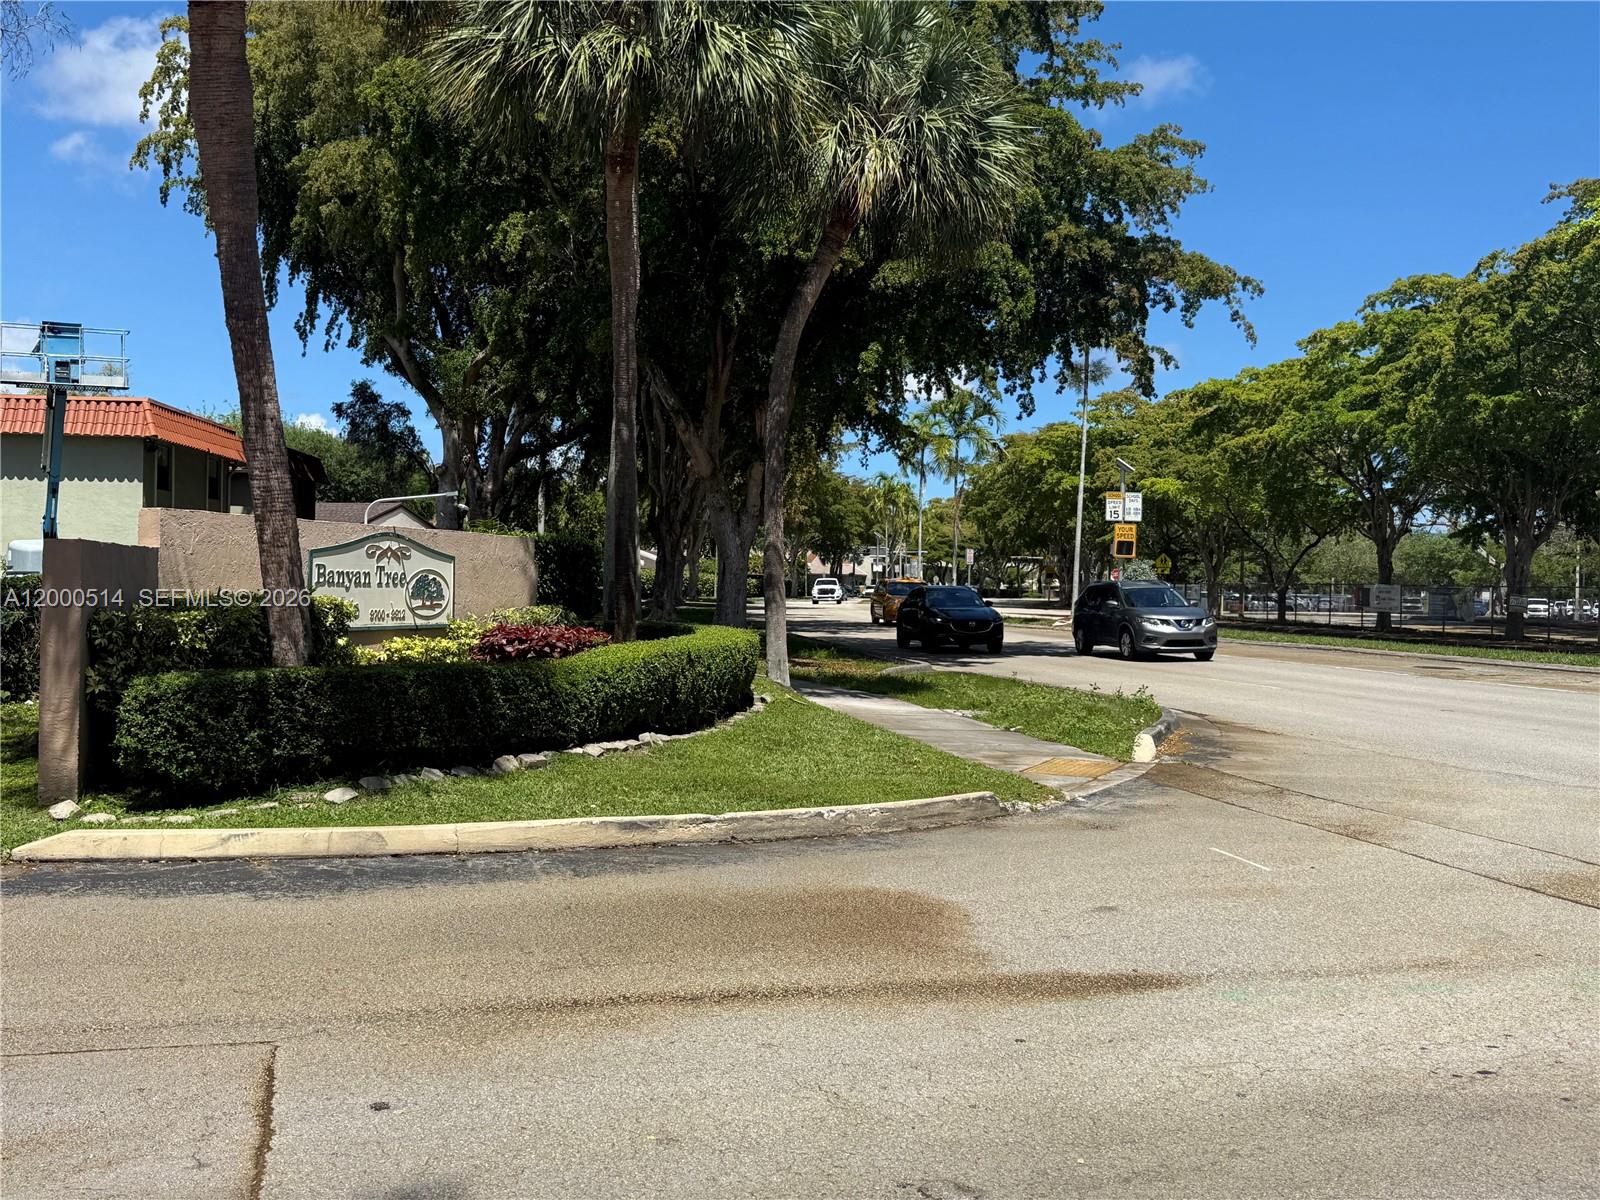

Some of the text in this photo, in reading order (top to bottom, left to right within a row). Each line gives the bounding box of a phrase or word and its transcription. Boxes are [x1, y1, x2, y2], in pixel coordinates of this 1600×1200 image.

[1109, 510, 1120, 519] 15
[315, 563, 406, 592] Banyan Tree
